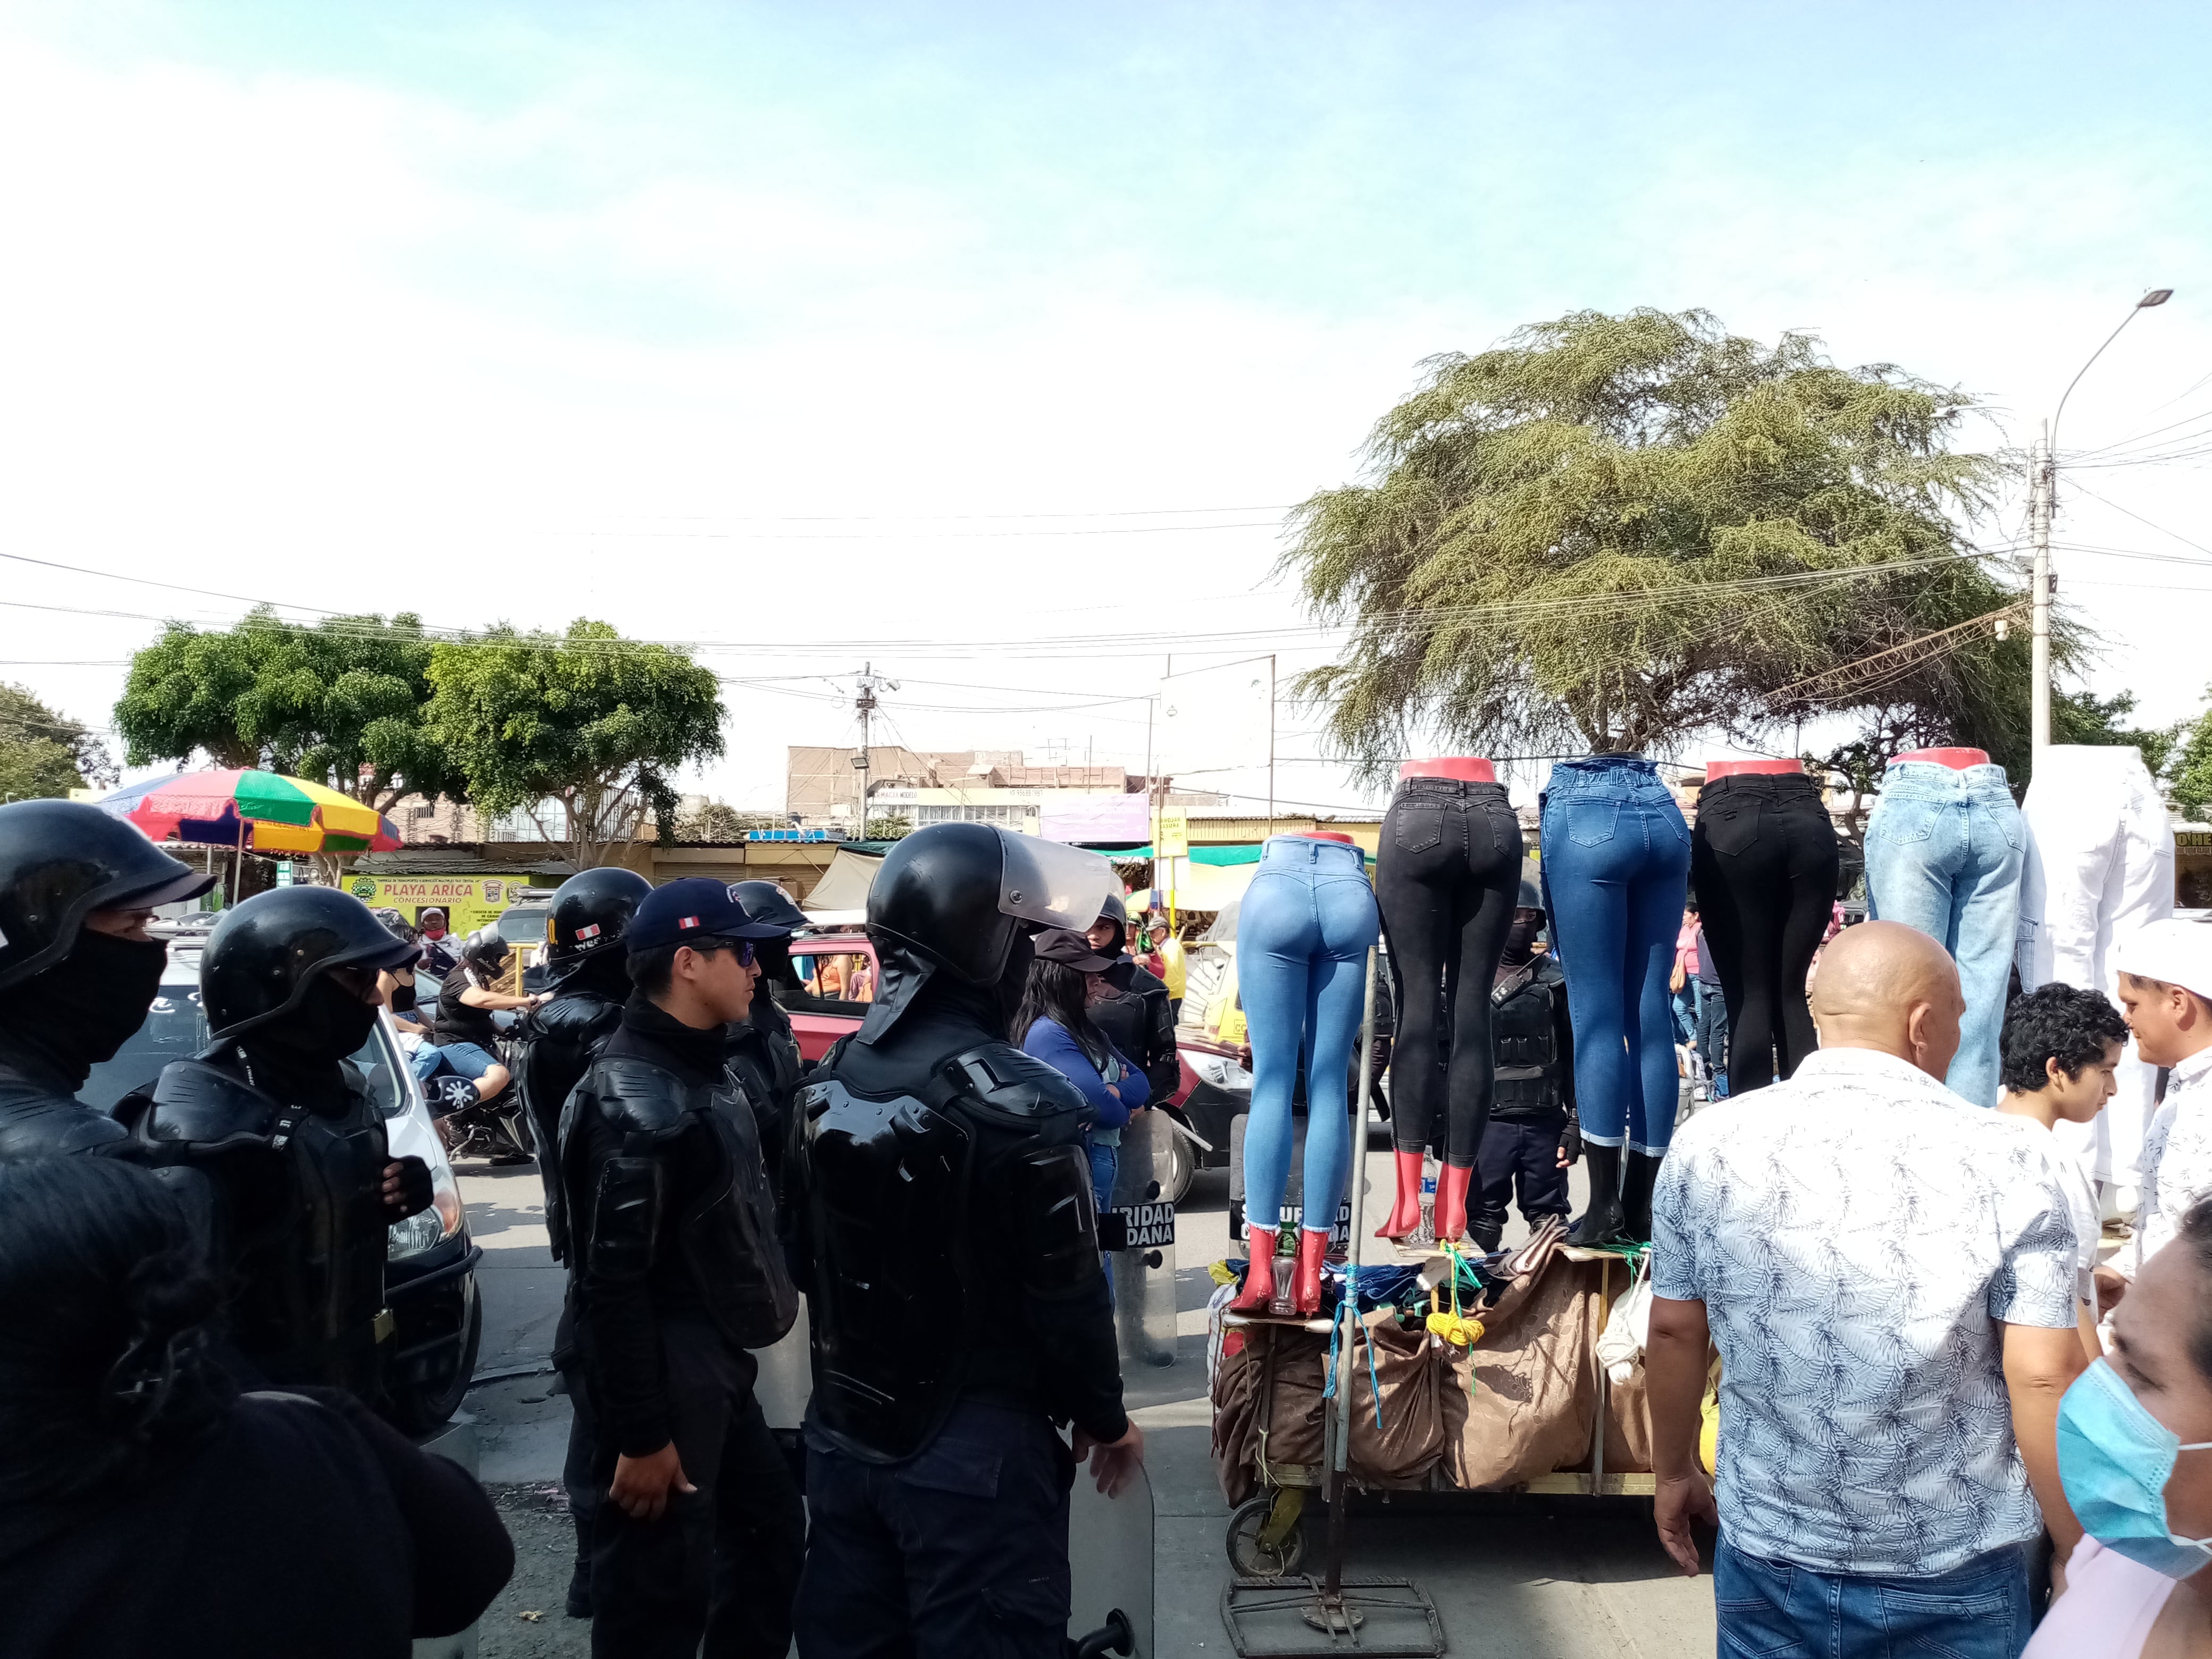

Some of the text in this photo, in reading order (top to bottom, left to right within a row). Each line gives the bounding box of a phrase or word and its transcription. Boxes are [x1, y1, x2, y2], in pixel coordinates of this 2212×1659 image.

[384, 884, 473, 896] PLAYA ARICA
[1112, 1203, 1175, 1227] RIDAD
